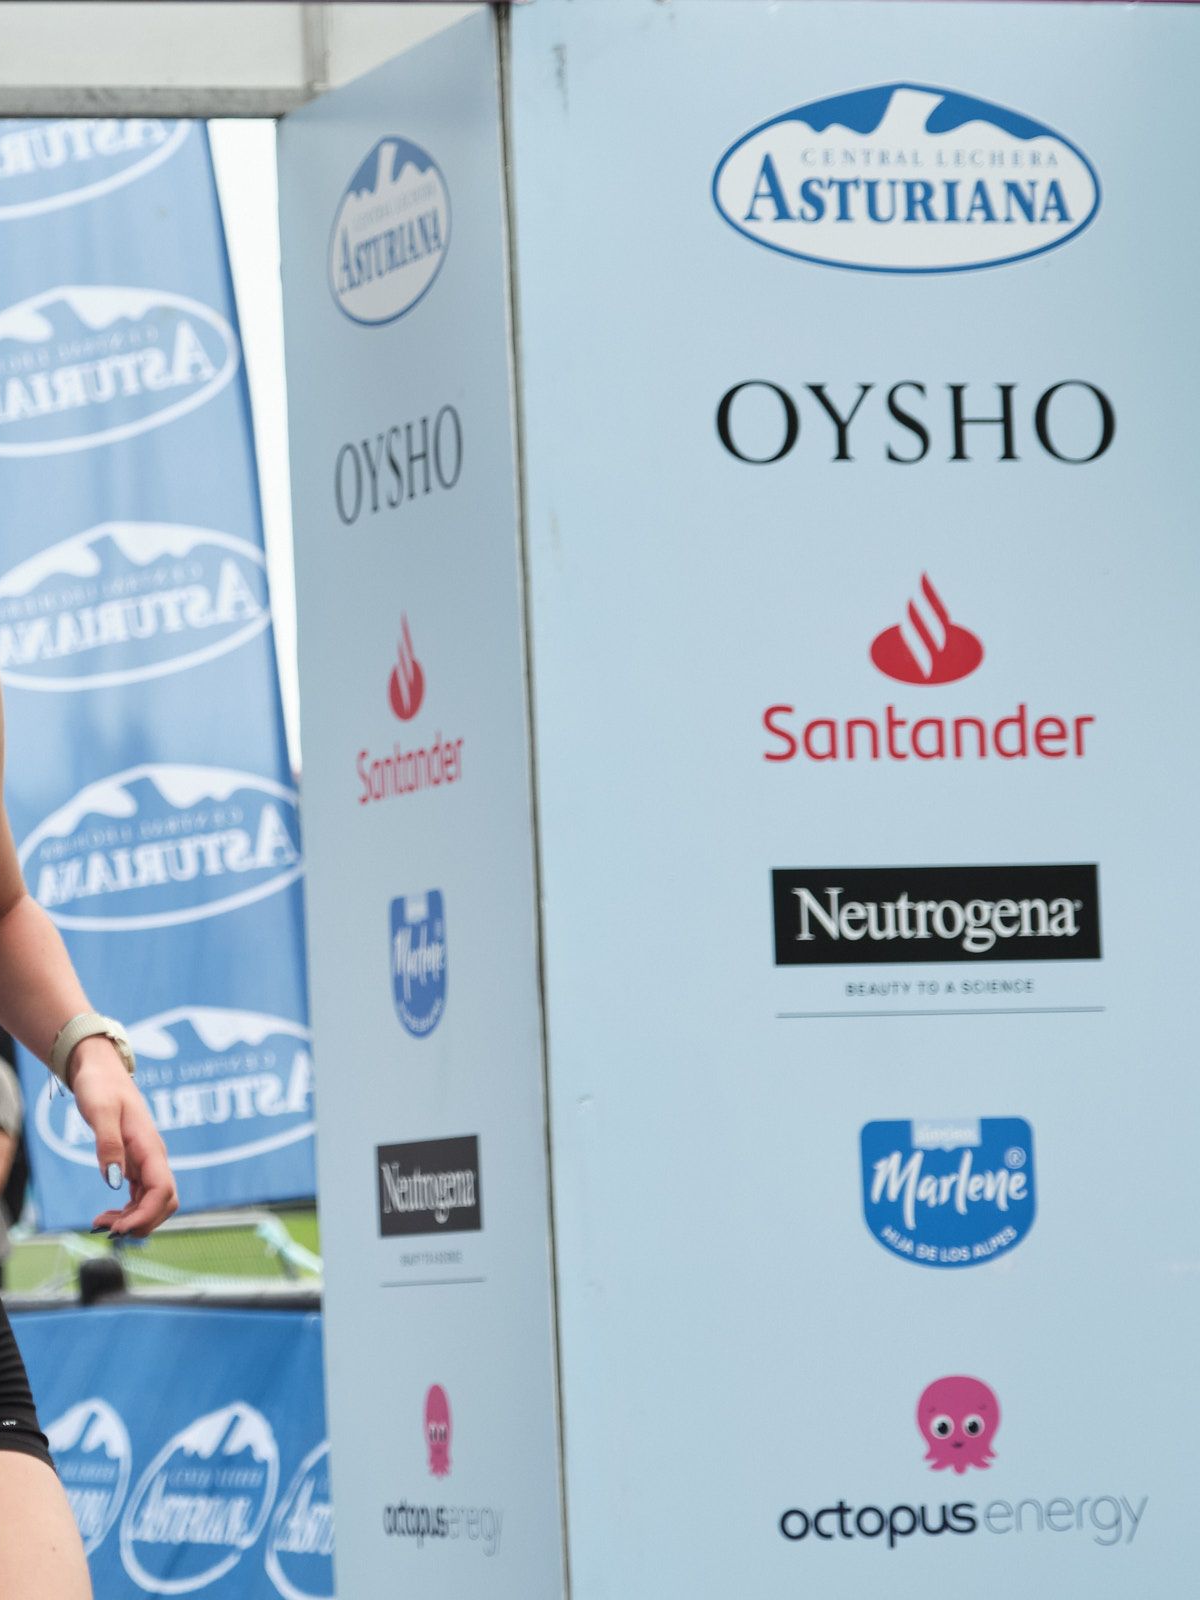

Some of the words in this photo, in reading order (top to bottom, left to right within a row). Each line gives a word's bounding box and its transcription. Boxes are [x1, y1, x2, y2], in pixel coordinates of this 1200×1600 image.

[743, 152, 1074, 224] ASTURIANA
[800, 148, 926, 168] CENTRAL
[936, 149, 1060, 168] LECHERA
[339, 207, 443, 294] ASTURIANA
[715, 379, 1116, 465] OYSHO
[335, 404, 463, 525] OYSHO
[761, 702, 1096, 762] Santander
[357, 731, 464, 805] Santander
[791, 886, 1081, 952] Neutrogena
[845, 981, 910, 997] BEAUTY
[918, 981, 940, 995] TO
[946, 981, 956, 994] A
[963, 977, 1035, 994] SCIENCE
[381, 1162, 476, 1224] Neutrogena
[871, 1149, 1028, 1230] Marlene
[916, 1243, 939, 1262] DE
[383, 1498, 449, 1549] octopus
[779, 1500, 979, 1549] octopus
[983, 1495, 1149, 1546] energy
